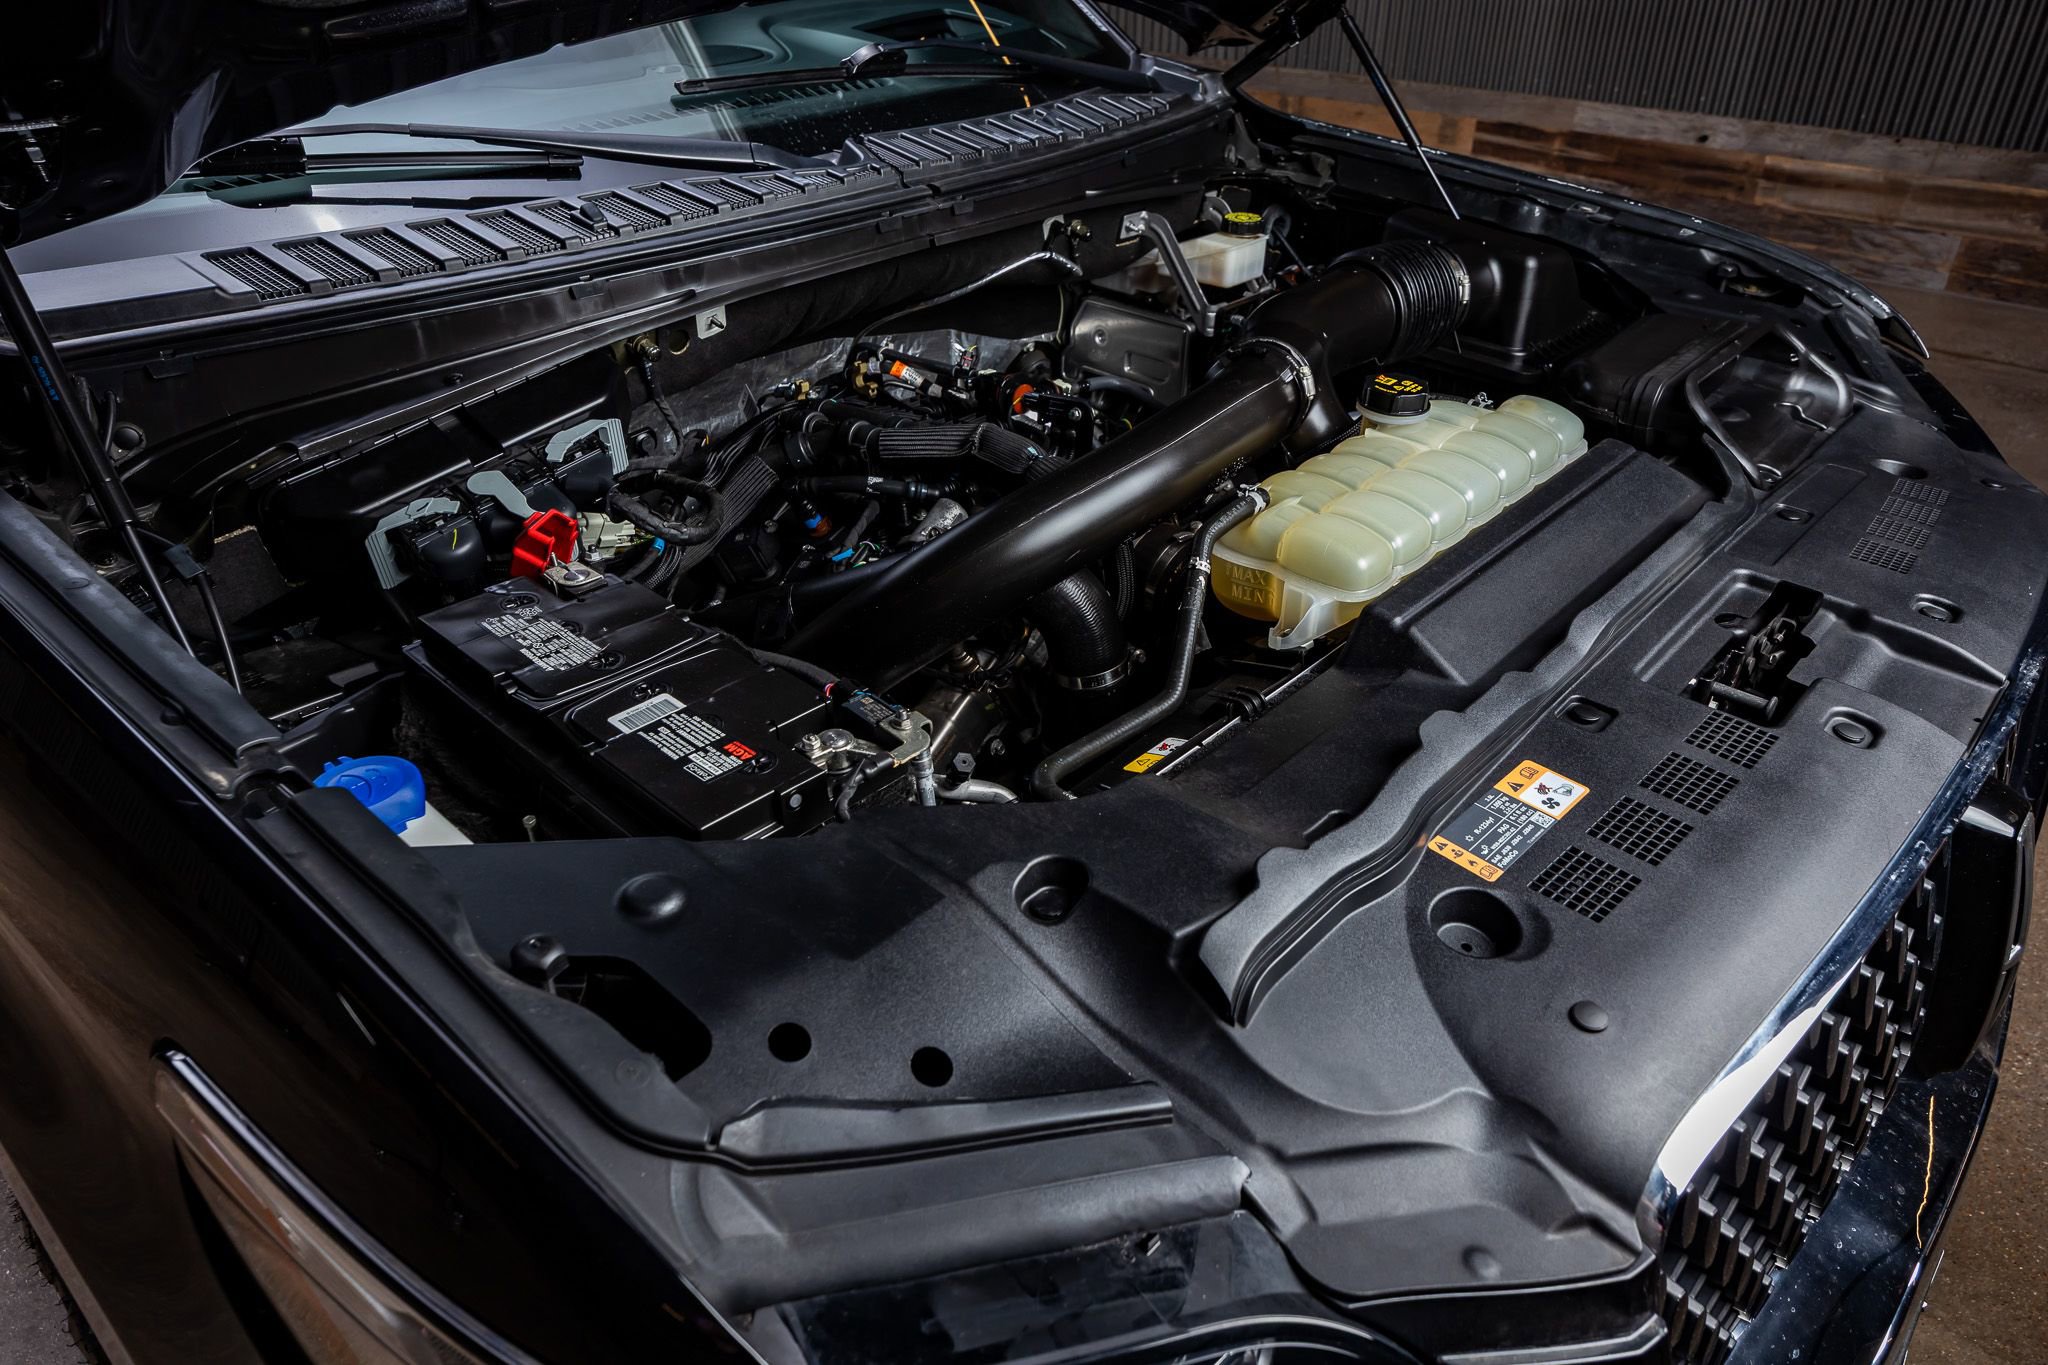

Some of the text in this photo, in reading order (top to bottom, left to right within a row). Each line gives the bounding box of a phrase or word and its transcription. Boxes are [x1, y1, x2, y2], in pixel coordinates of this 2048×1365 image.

[1232, 565, 1266, 585] MAX
[1231, 583, 1265, 603] MIN
[724, 743, 752, 760] AGM
[1497, 823, 1510, 834] PAG
[1497, 850, 1519, 868] FoMoCo
